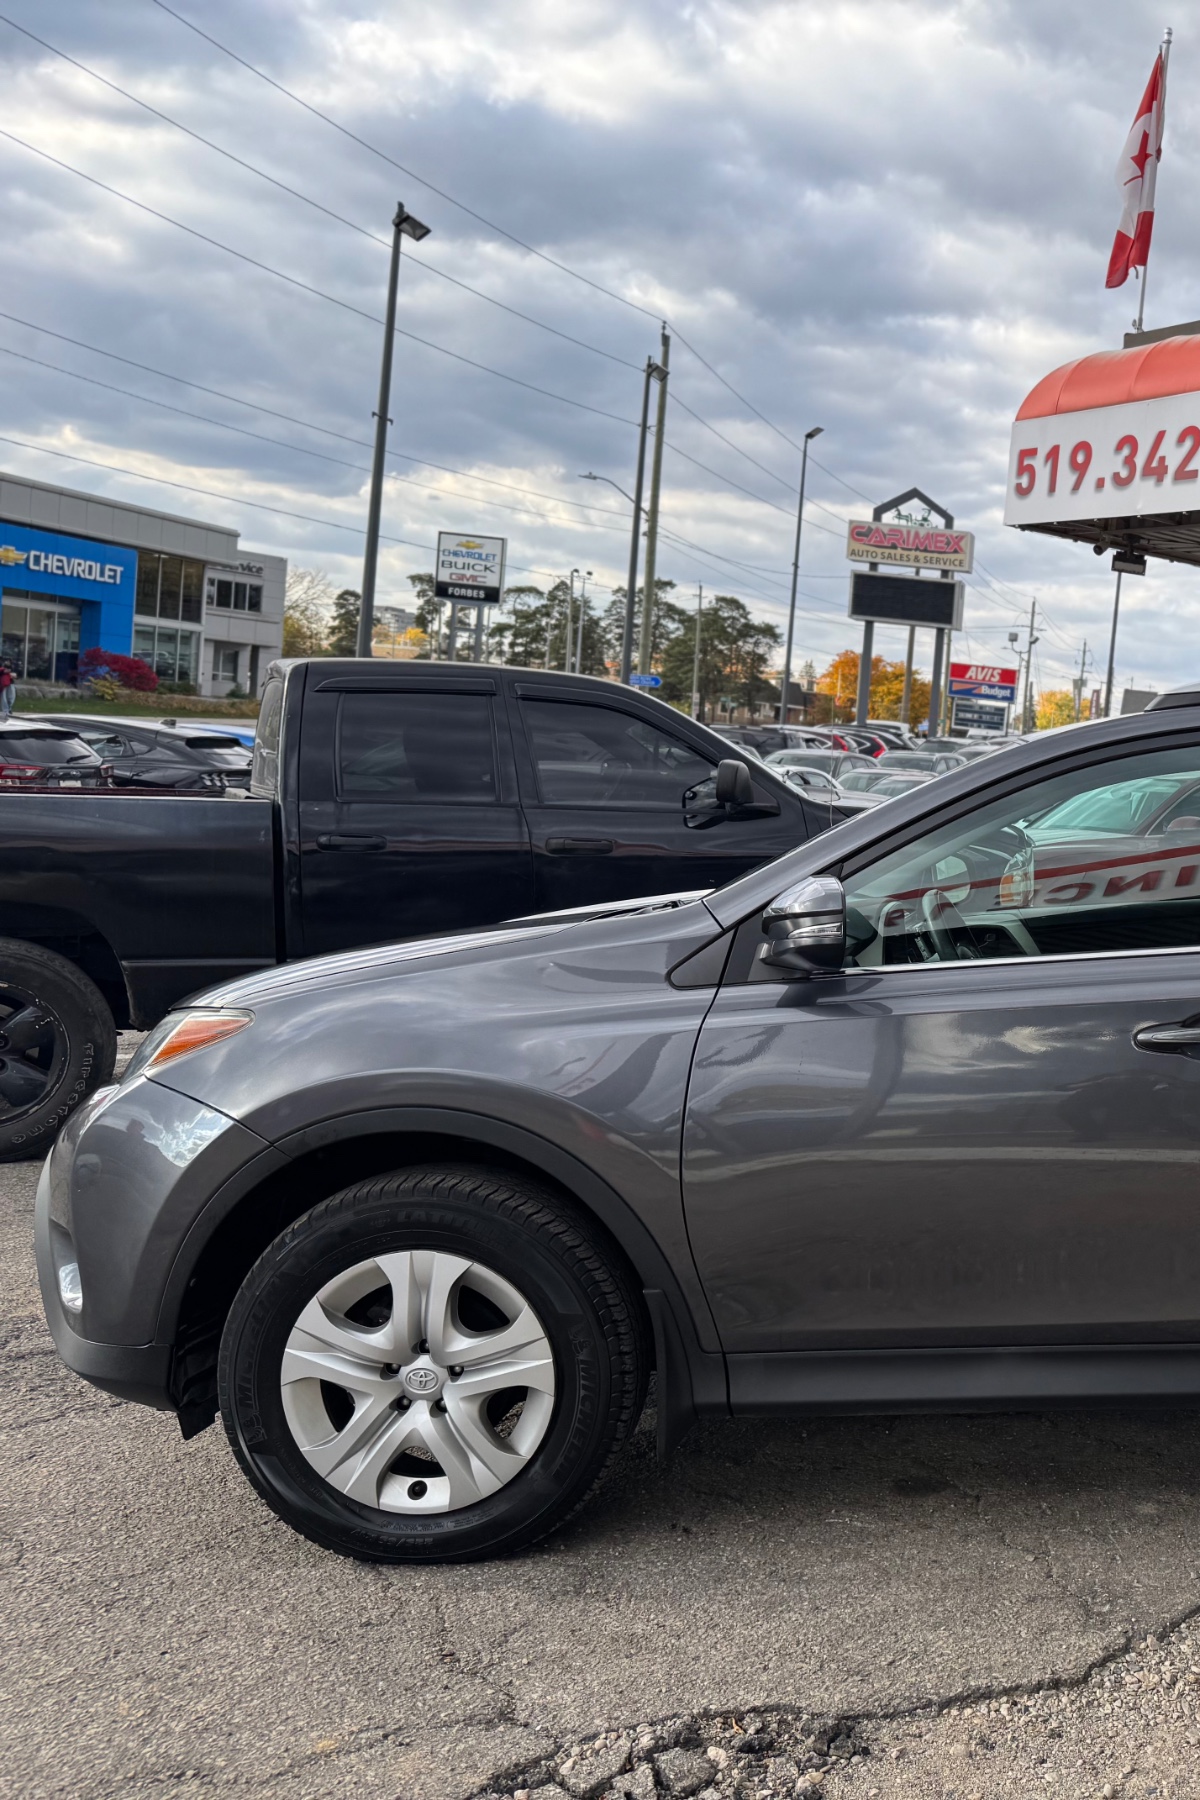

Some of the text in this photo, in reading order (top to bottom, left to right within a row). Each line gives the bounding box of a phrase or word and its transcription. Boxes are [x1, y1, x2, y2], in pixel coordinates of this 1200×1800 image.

[850, 524, 967, 554] CARIMEX
[442, 548, 498, 561] CHEVROLET
[850, 548, 964, 567] AUTO SALES & SERVICE
[28, 549, 124, 585] CHEVROLET
[441, 560, 496, 573] BUICK
[450, 573, 487, 584] GMC
[448, 587, 486, 598] FORBES
[965, 666, 1002, 683] AVIS
[982, 685, 1011, 698] Budget
